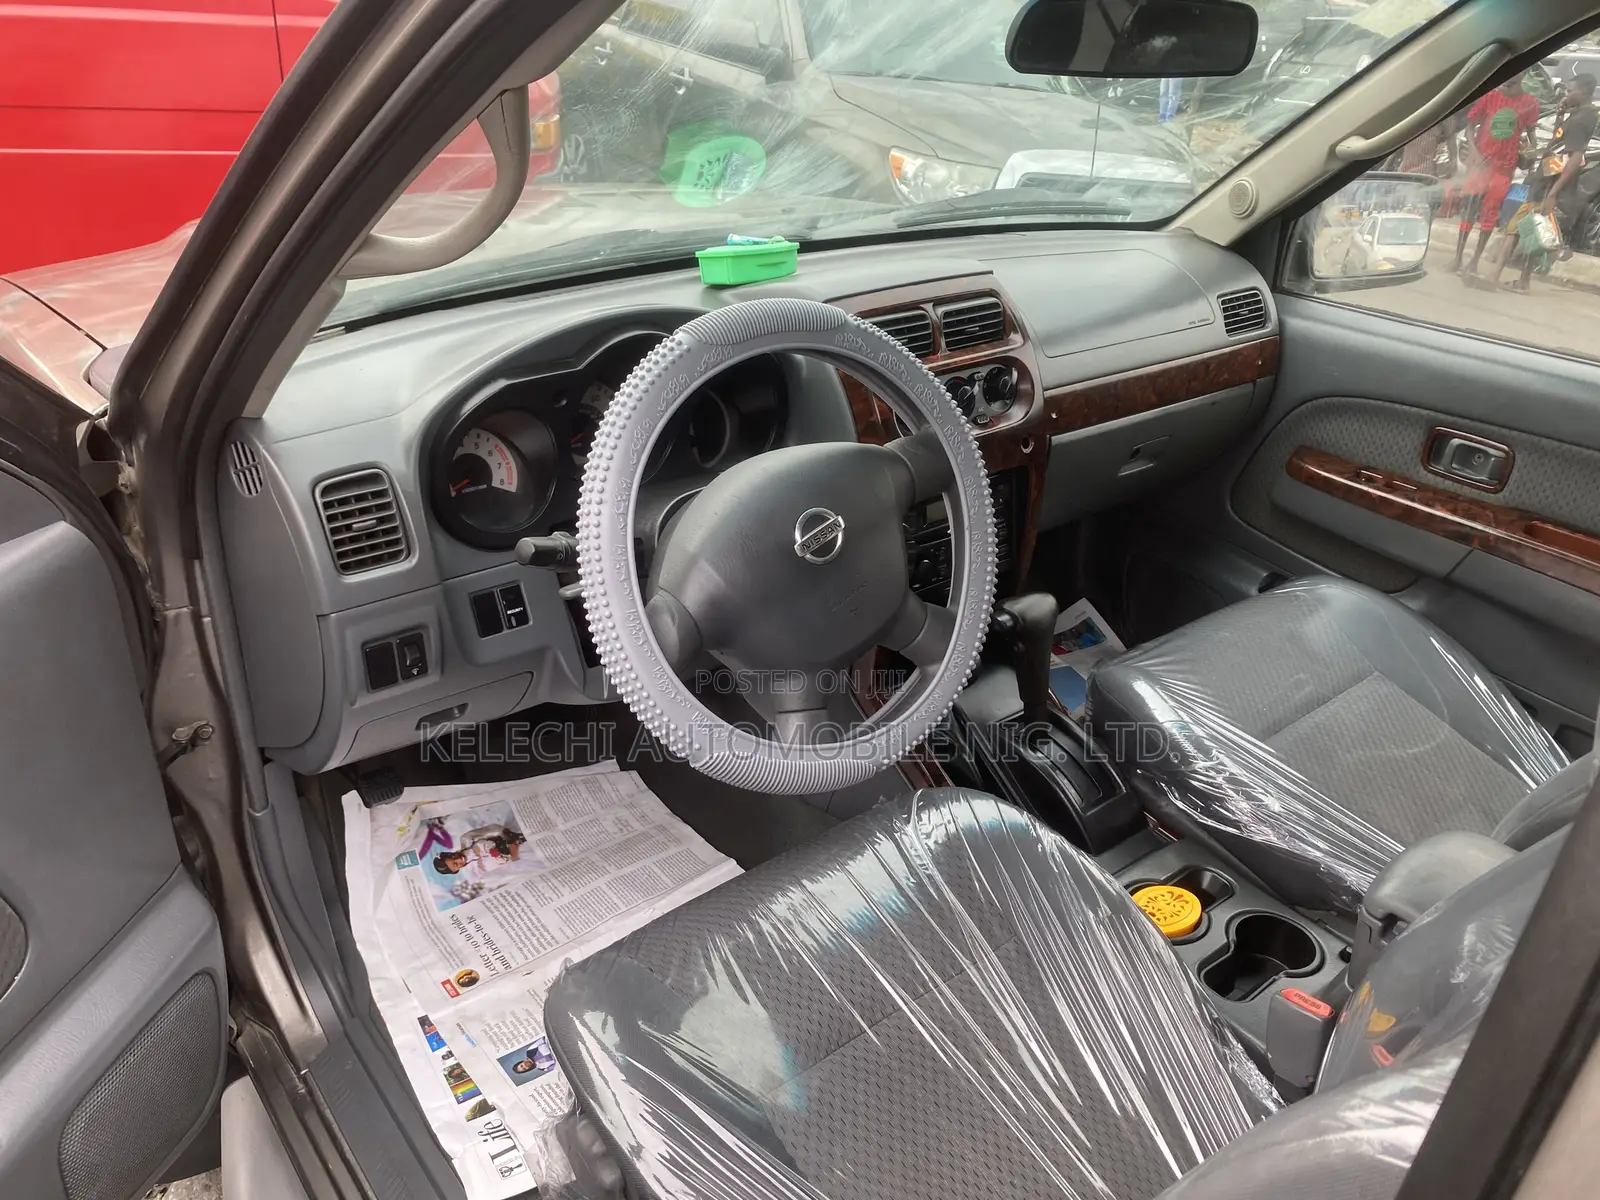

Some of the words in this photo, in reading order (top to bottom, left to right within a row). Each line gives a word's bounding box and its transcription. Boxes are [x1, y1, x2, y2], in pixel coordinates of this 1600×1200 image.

[801, 520, 842, 552] NISSAN
[506, 606, 524, 614] SECURITY
[449, 914, 468, 935] brides
[480, 953, 500, 976] Letter
[495, 955, 512, 970] and
[1294, 992, 1322, 1010] PRESS
[478, 1118, 520, 1164] Life
